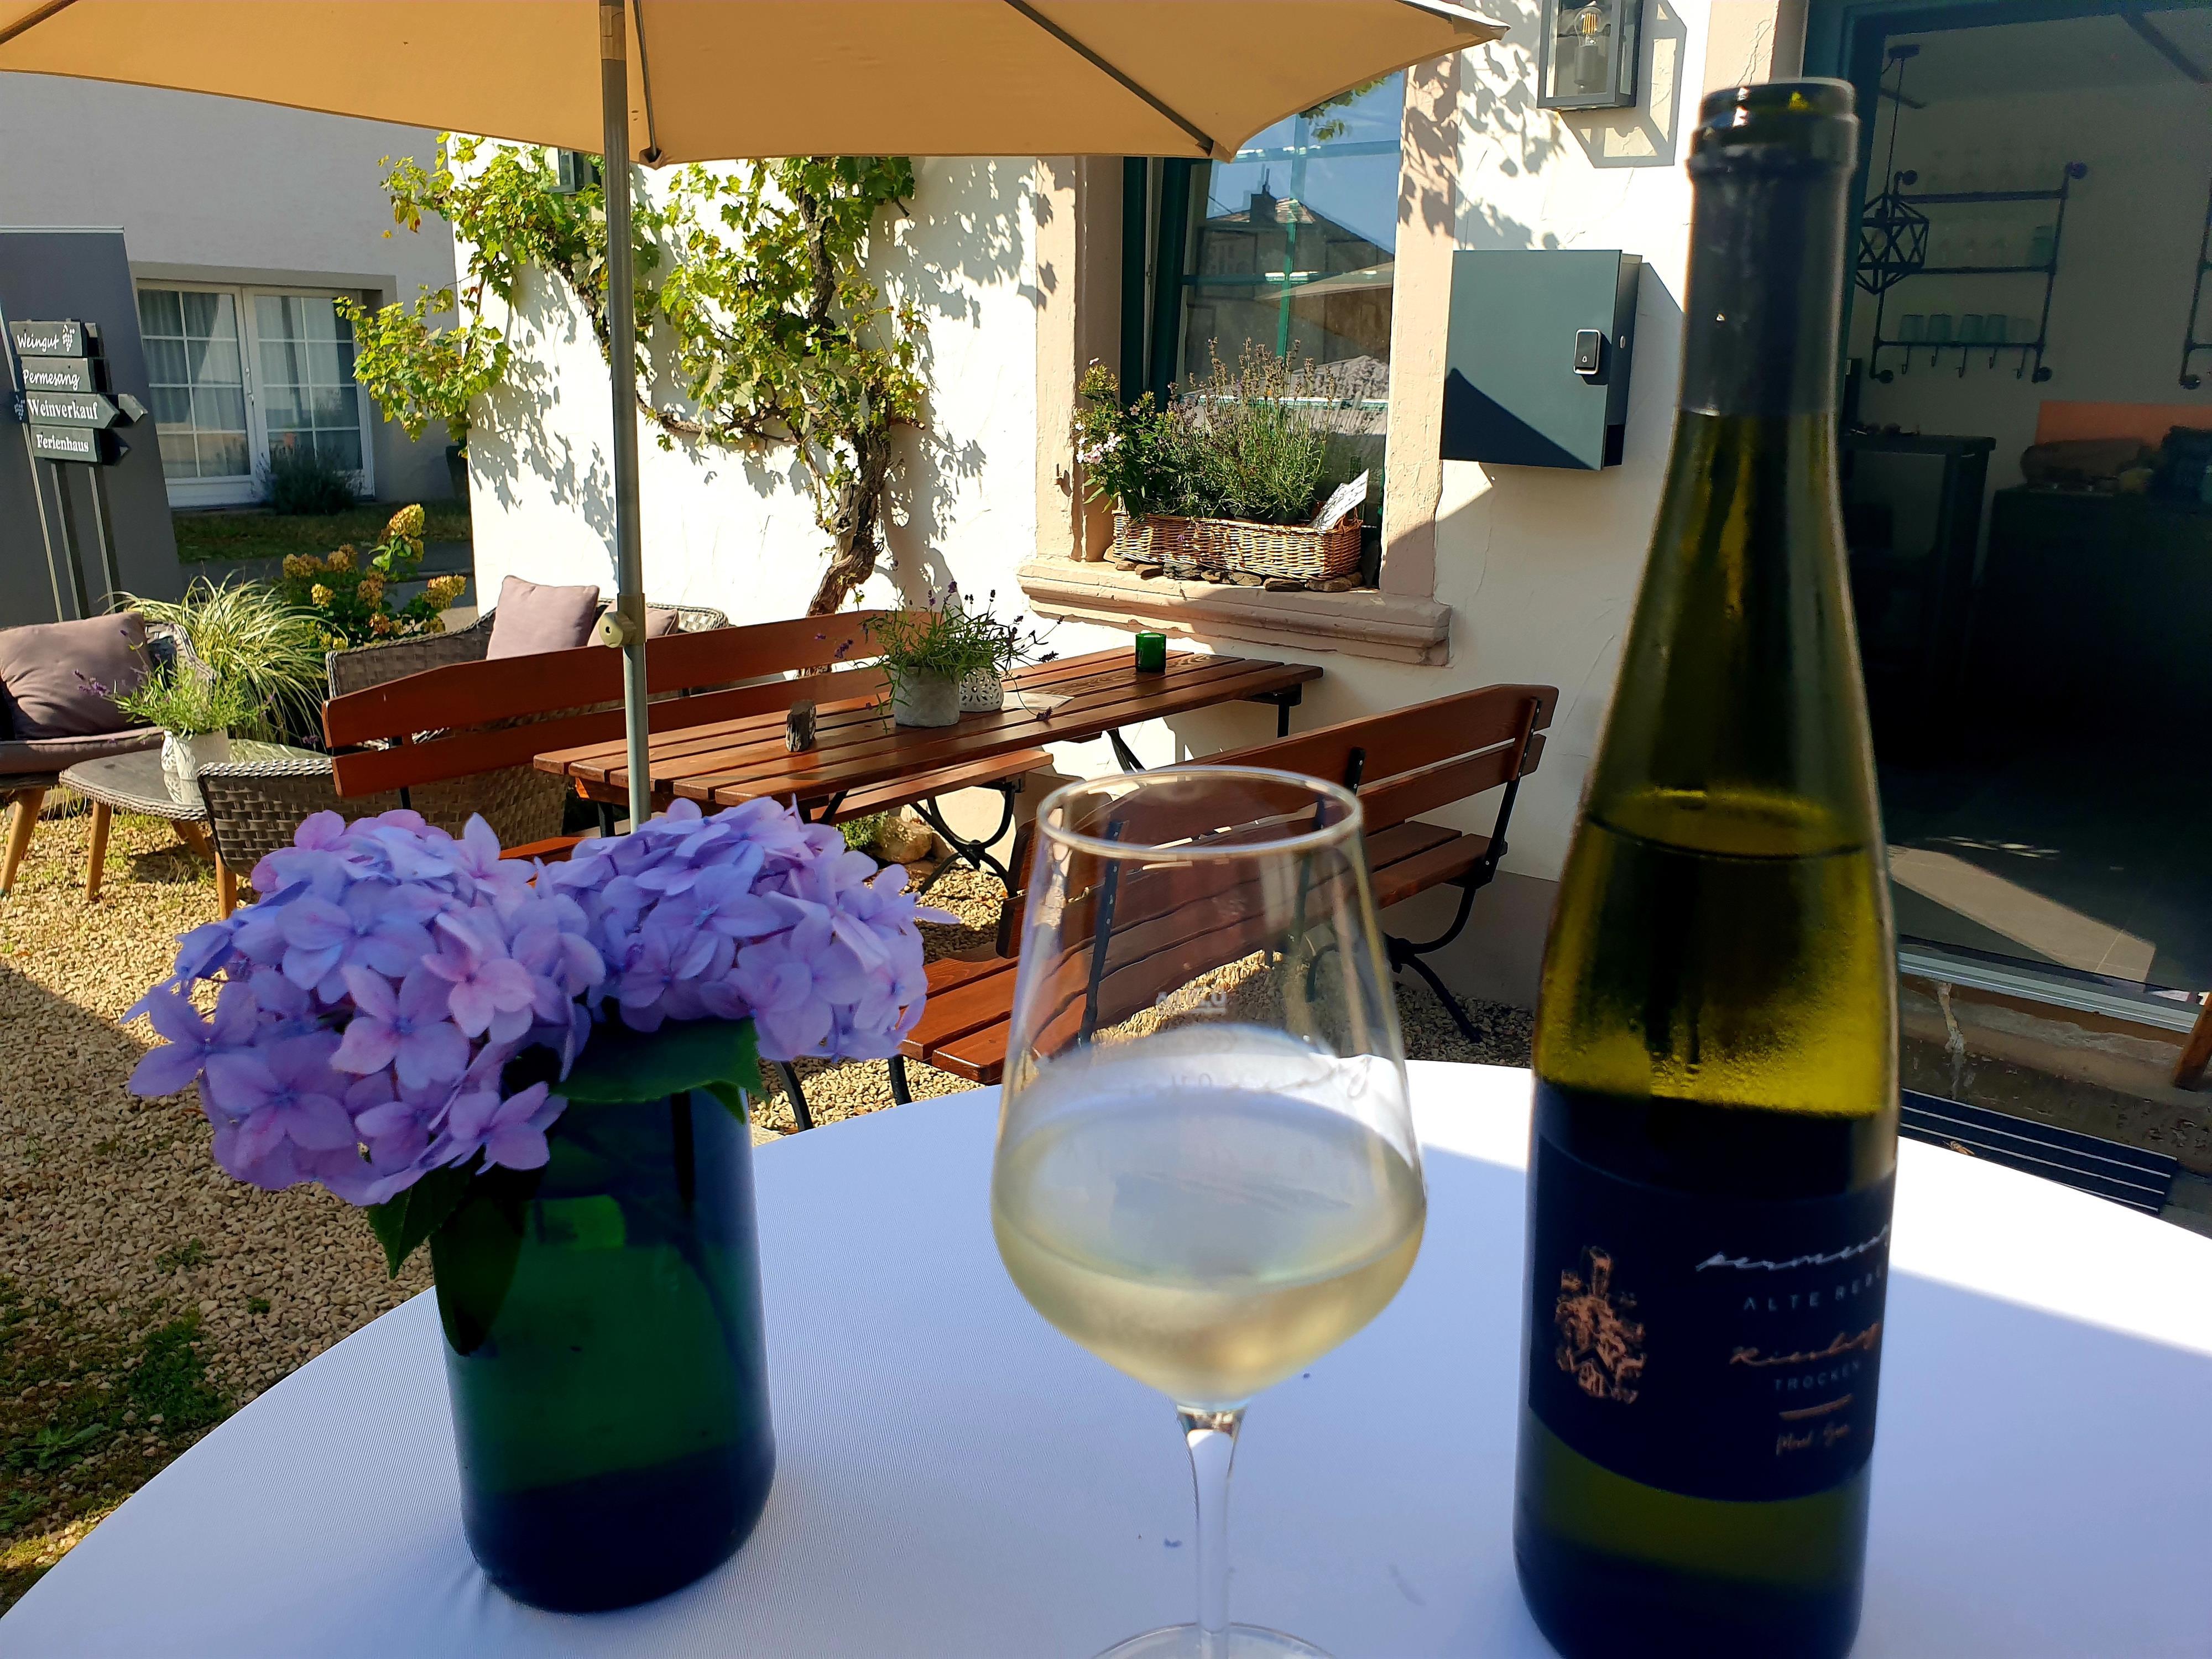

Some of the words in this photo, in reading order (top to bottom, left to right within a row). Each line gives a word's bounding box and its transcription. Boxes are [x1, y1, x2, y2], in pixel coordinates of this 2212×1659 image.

[17, 332, 59, 353] Weingut
[23, 369, 80, 391] Permesang
[28, 398, 98, 420] Weinverkauf
[36, 434, 89, 452] Ferienhaus
[1743, 1291, 1820, 1312] ALTE
[1774, 1360, 1860, 1390] TROCKEN
